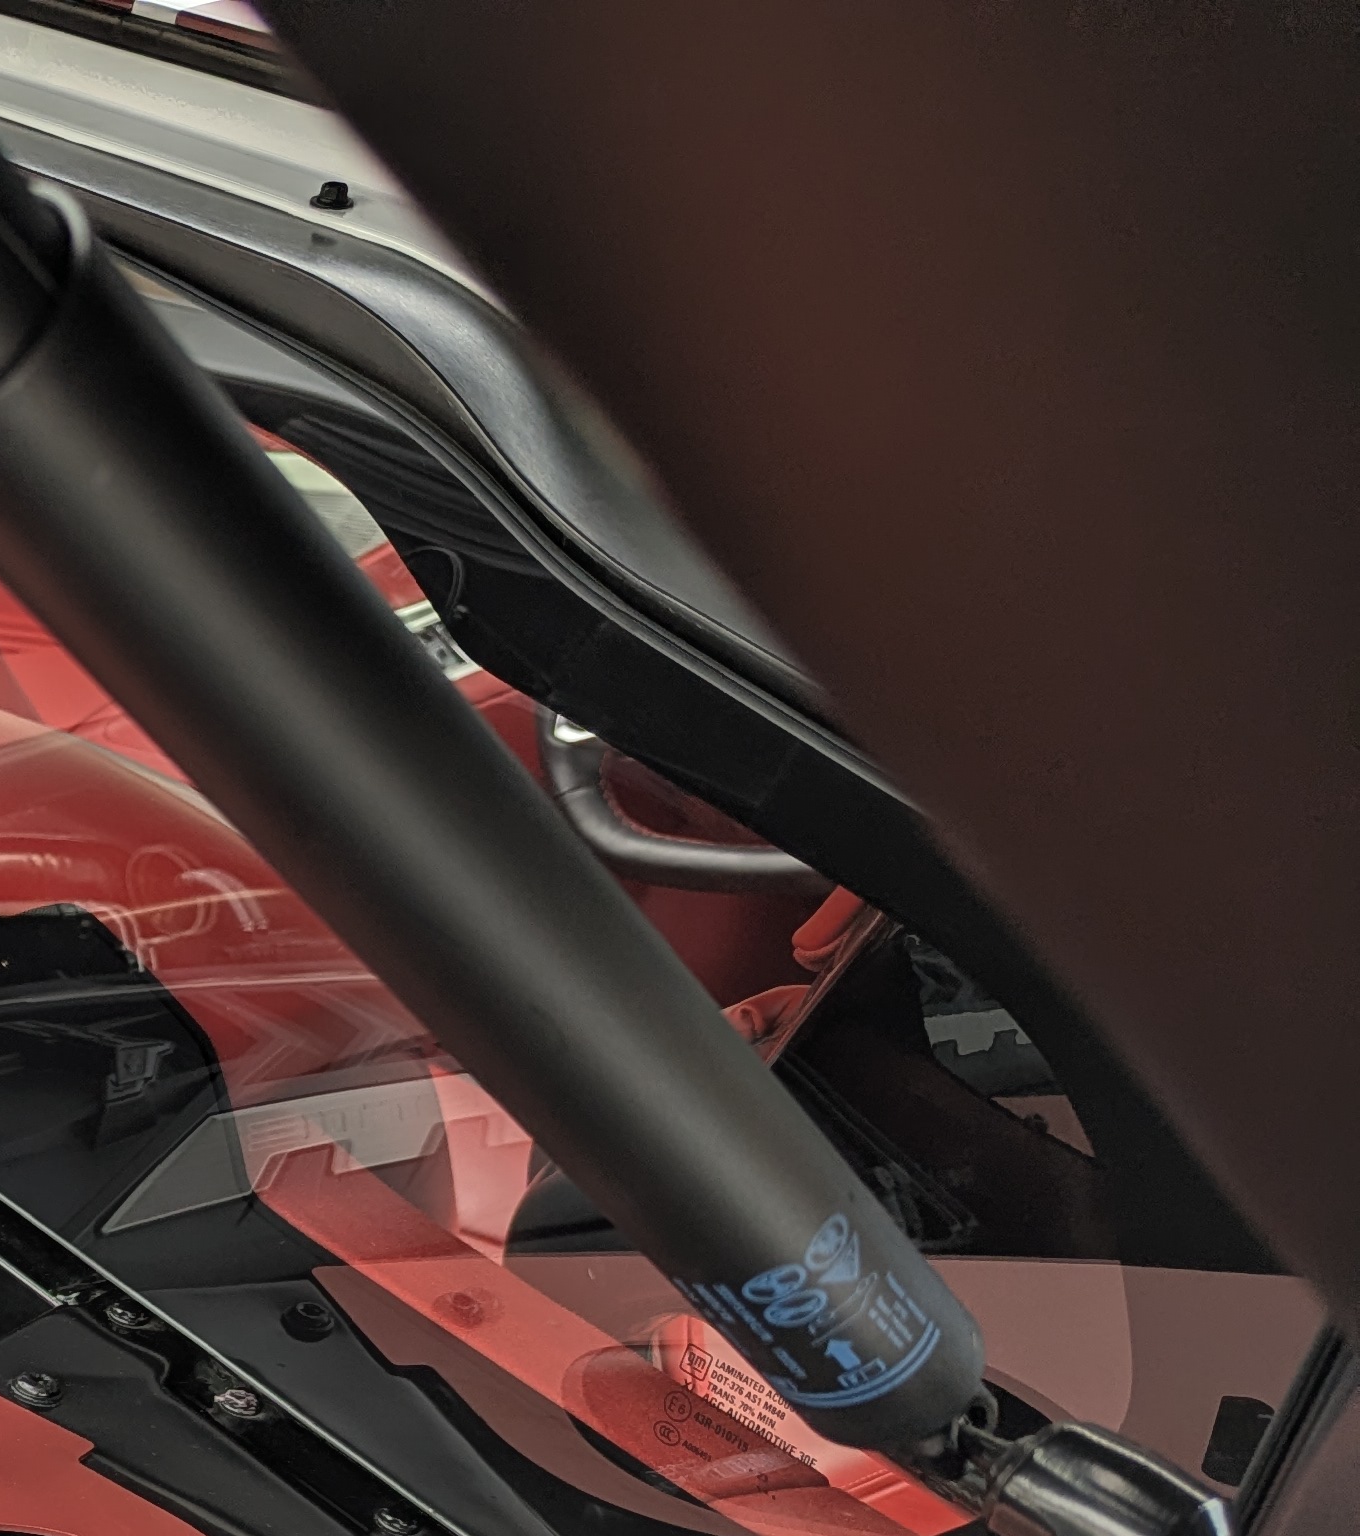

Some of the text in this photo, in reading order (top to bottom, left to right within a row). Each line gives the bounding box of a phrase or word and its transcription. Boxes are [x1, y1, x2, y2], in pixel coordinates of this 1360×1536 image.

[711, 1369, 786, 1420] DOT-376 AS1 M848
[715, 1358, 765, 1394] LAMINATED
[708, 1380, 777, 1431] TRANS. 70% MIN.
[726, 1407, 797, 1459] AUTOMOTIVE
